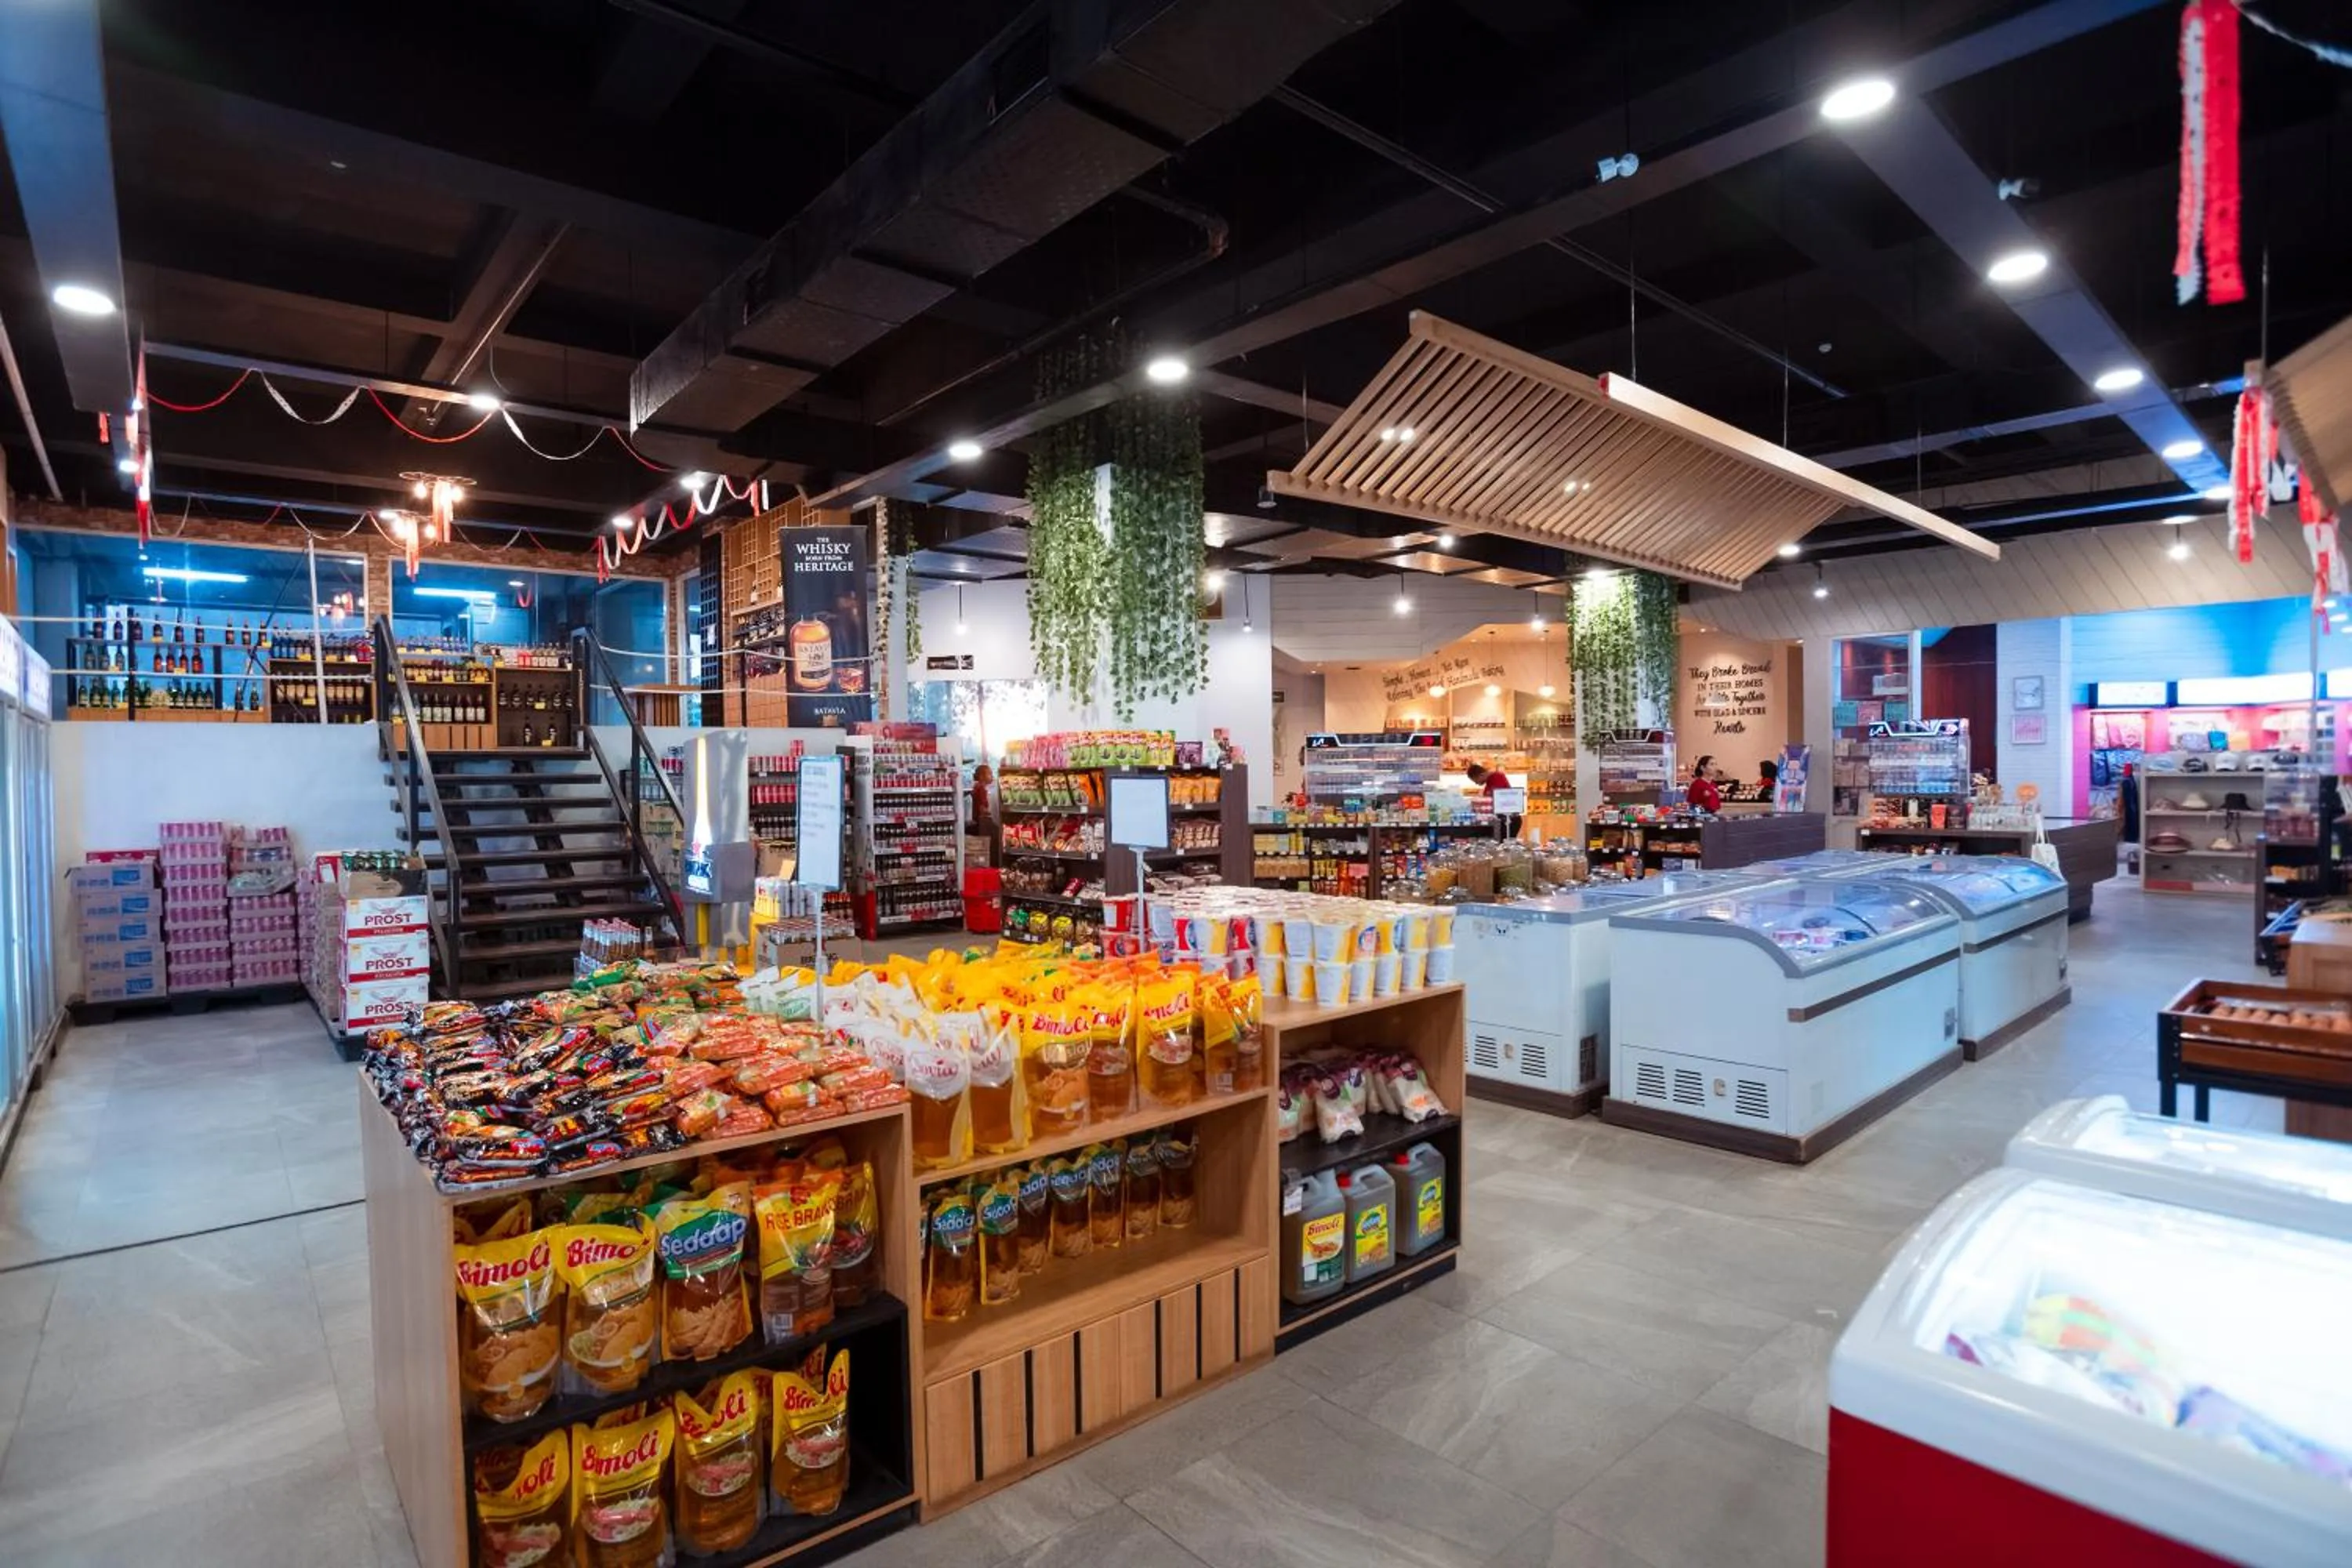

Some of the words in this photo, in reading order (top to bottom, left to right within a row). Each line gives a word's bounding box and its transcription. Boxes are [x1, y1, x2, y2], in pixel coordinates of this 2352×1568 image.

[795, 543, 851, 554] WHISKY
[794, 561, 854, 572] HERITAGE
[1688, 666, 1710, 681] They
[1734, 678, 1763, 688] HOMES
[364, 912, 413, 926] PROST
[365, 957, 414, 971] PROST
[659, 1214, 749, 1255] Sedaap
[565, 1237, 650, 1269] Bimo
[457, 1240, 551, 1287] Bimoli
